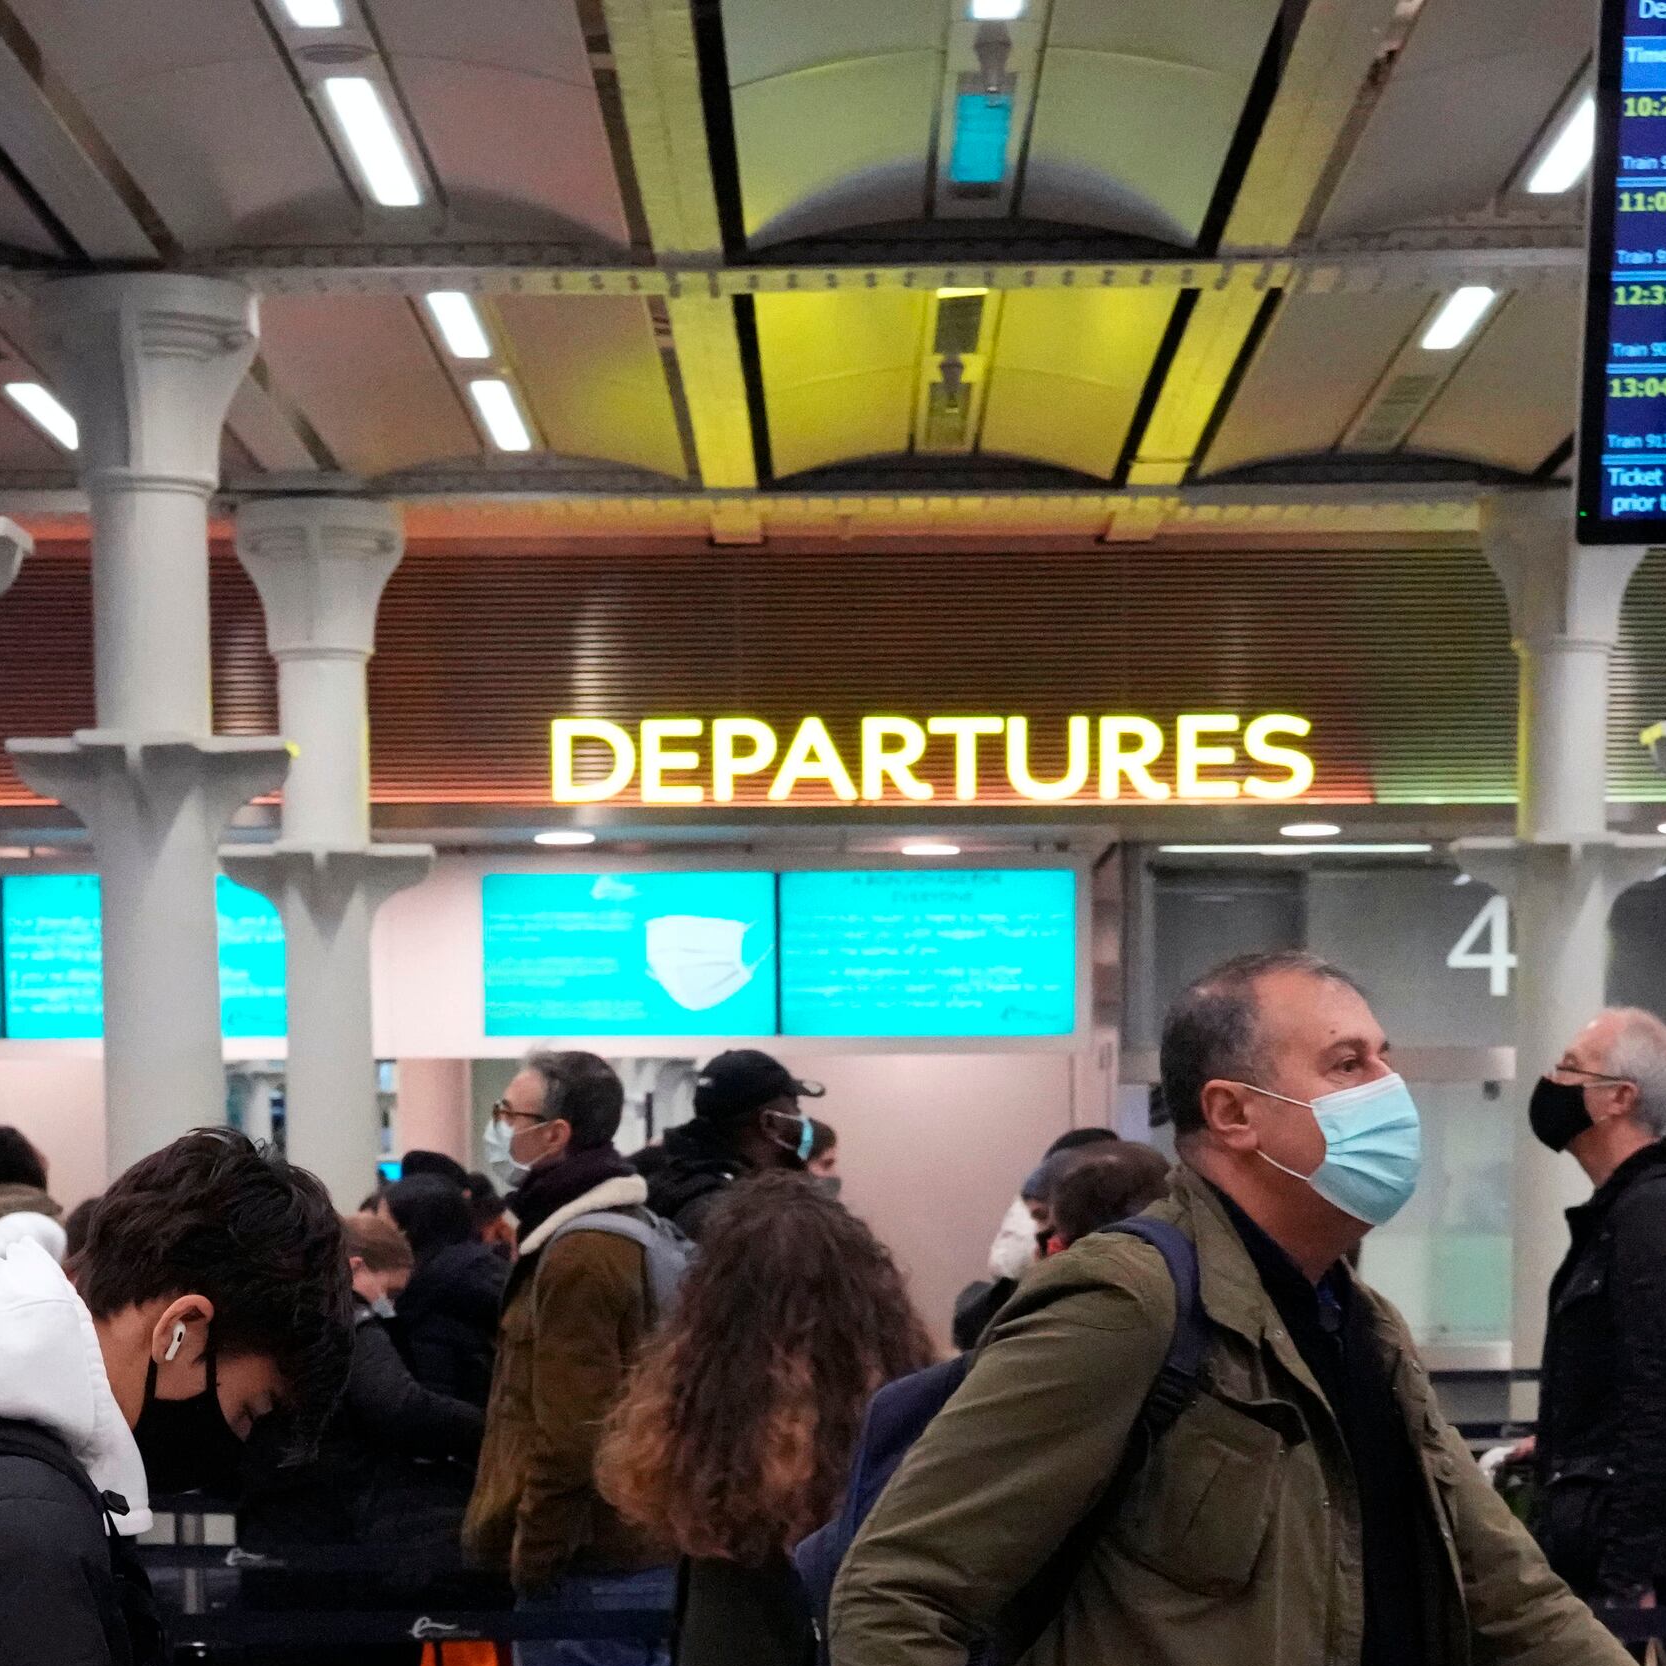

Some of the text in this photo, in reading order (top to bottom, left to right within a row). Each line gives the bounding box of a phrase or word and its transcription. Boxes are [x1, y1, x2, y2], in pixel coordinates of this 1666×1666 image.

[1623, 156, 1658, 170] Train
[1617, 250, 1651, 264] Train
[1612, 343, 1647, 357] Train
[1607, 434, 1643, 449] Train
[1608, 468, 1663, 486] Ticket
[1612, 493, 1657, 514] prior
[550, 714, 1315, 803] DEPARTURES
[1446, 895, 1517, 996] 4
